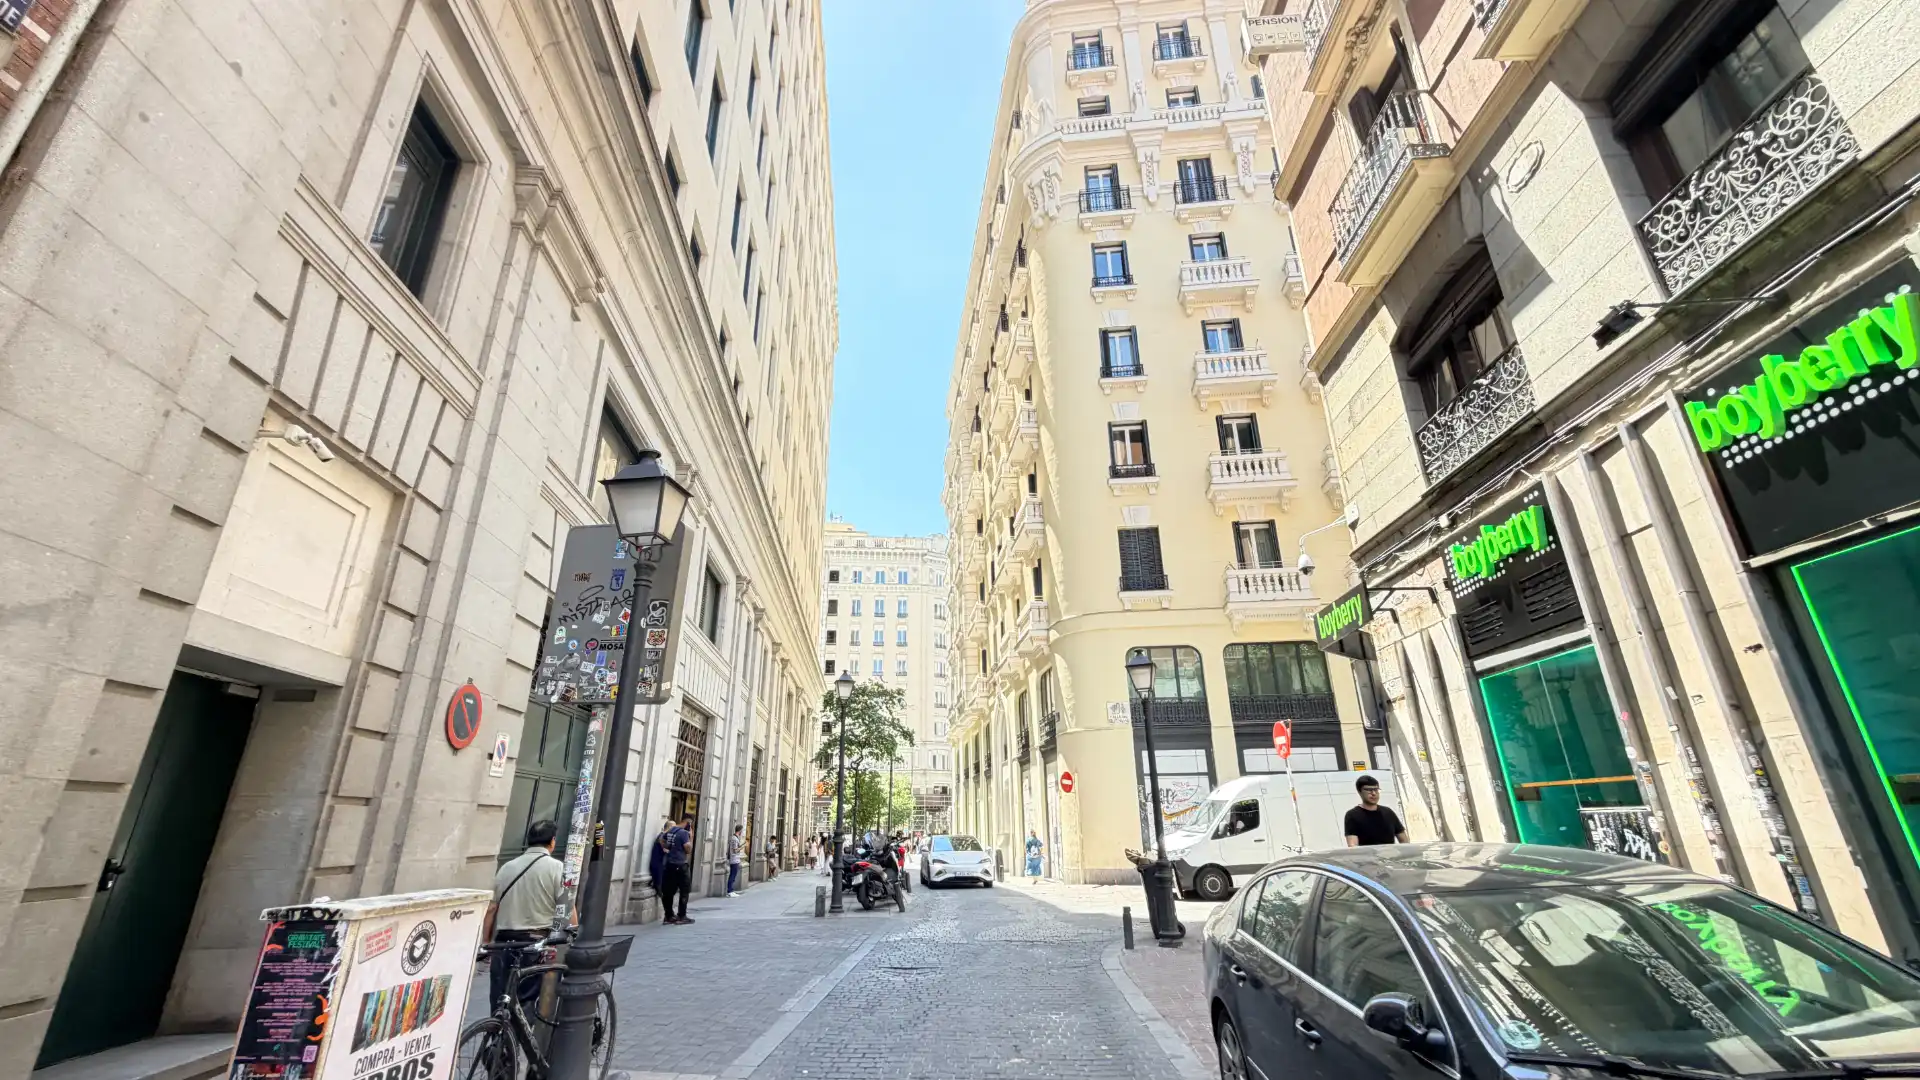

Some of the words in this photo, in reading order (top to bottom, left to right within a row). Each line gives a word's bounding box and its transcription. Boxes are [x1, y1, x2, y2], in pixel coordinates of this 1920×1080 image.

[1248, 16, 1298, 27] PENSION
[1684, 293, 1920, 453] boyberry
[1448, 505, 1548, 581] boyberry
[1316, 594, 1363, 641] boyberry
[354, 1046, 396, 1077] COMPRA
[404, 1033, 433, 1058] VENTA
